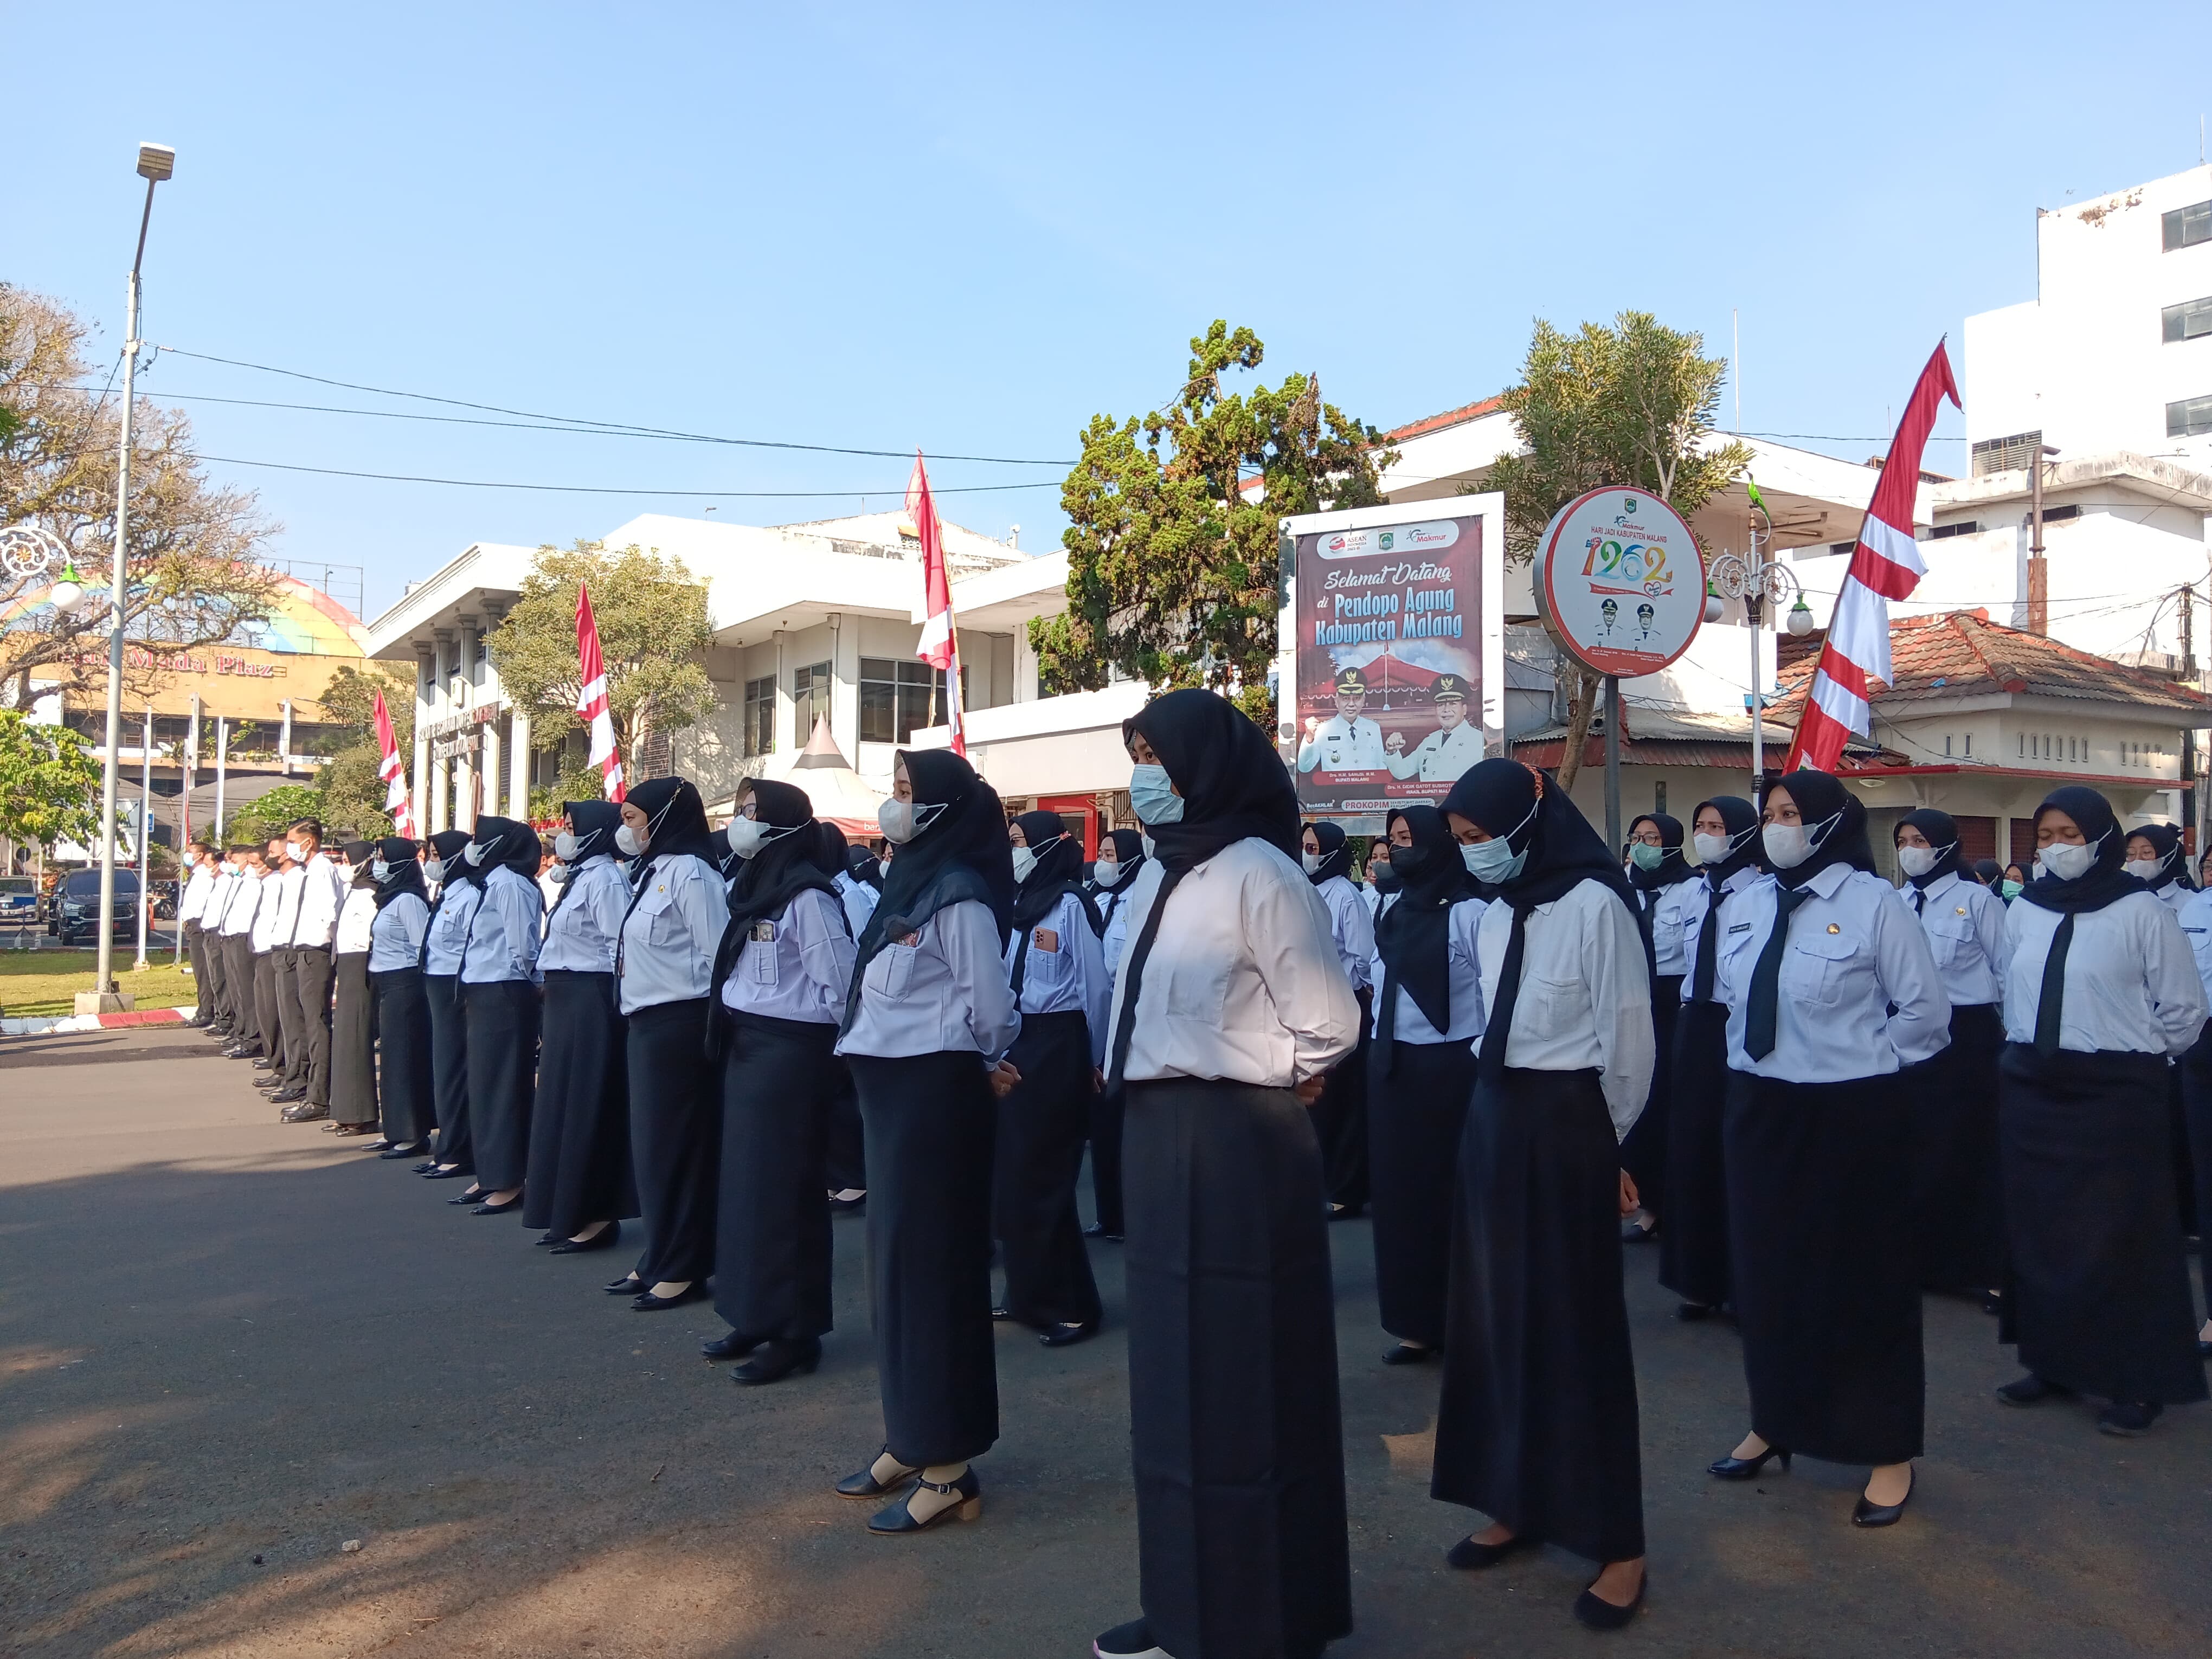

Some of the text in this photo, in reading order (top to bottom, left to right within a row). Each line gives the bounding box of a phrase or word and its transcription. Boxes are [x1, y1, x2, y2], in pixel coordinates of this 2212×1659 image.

[1417, 534, 1446, 543] Makmur
[1617, 530, 1645, 540] KABUPATEN
[1647, 535, 1667, 543] MALANG
[1580, 537, 1673, 583] 1262
[1324, 562, 1452, 590] Selamat Datang
[1317, 587, 1455, 618] di Pendopo Agung
[1315, 612, 1462, 646] Kabupaten Malang
